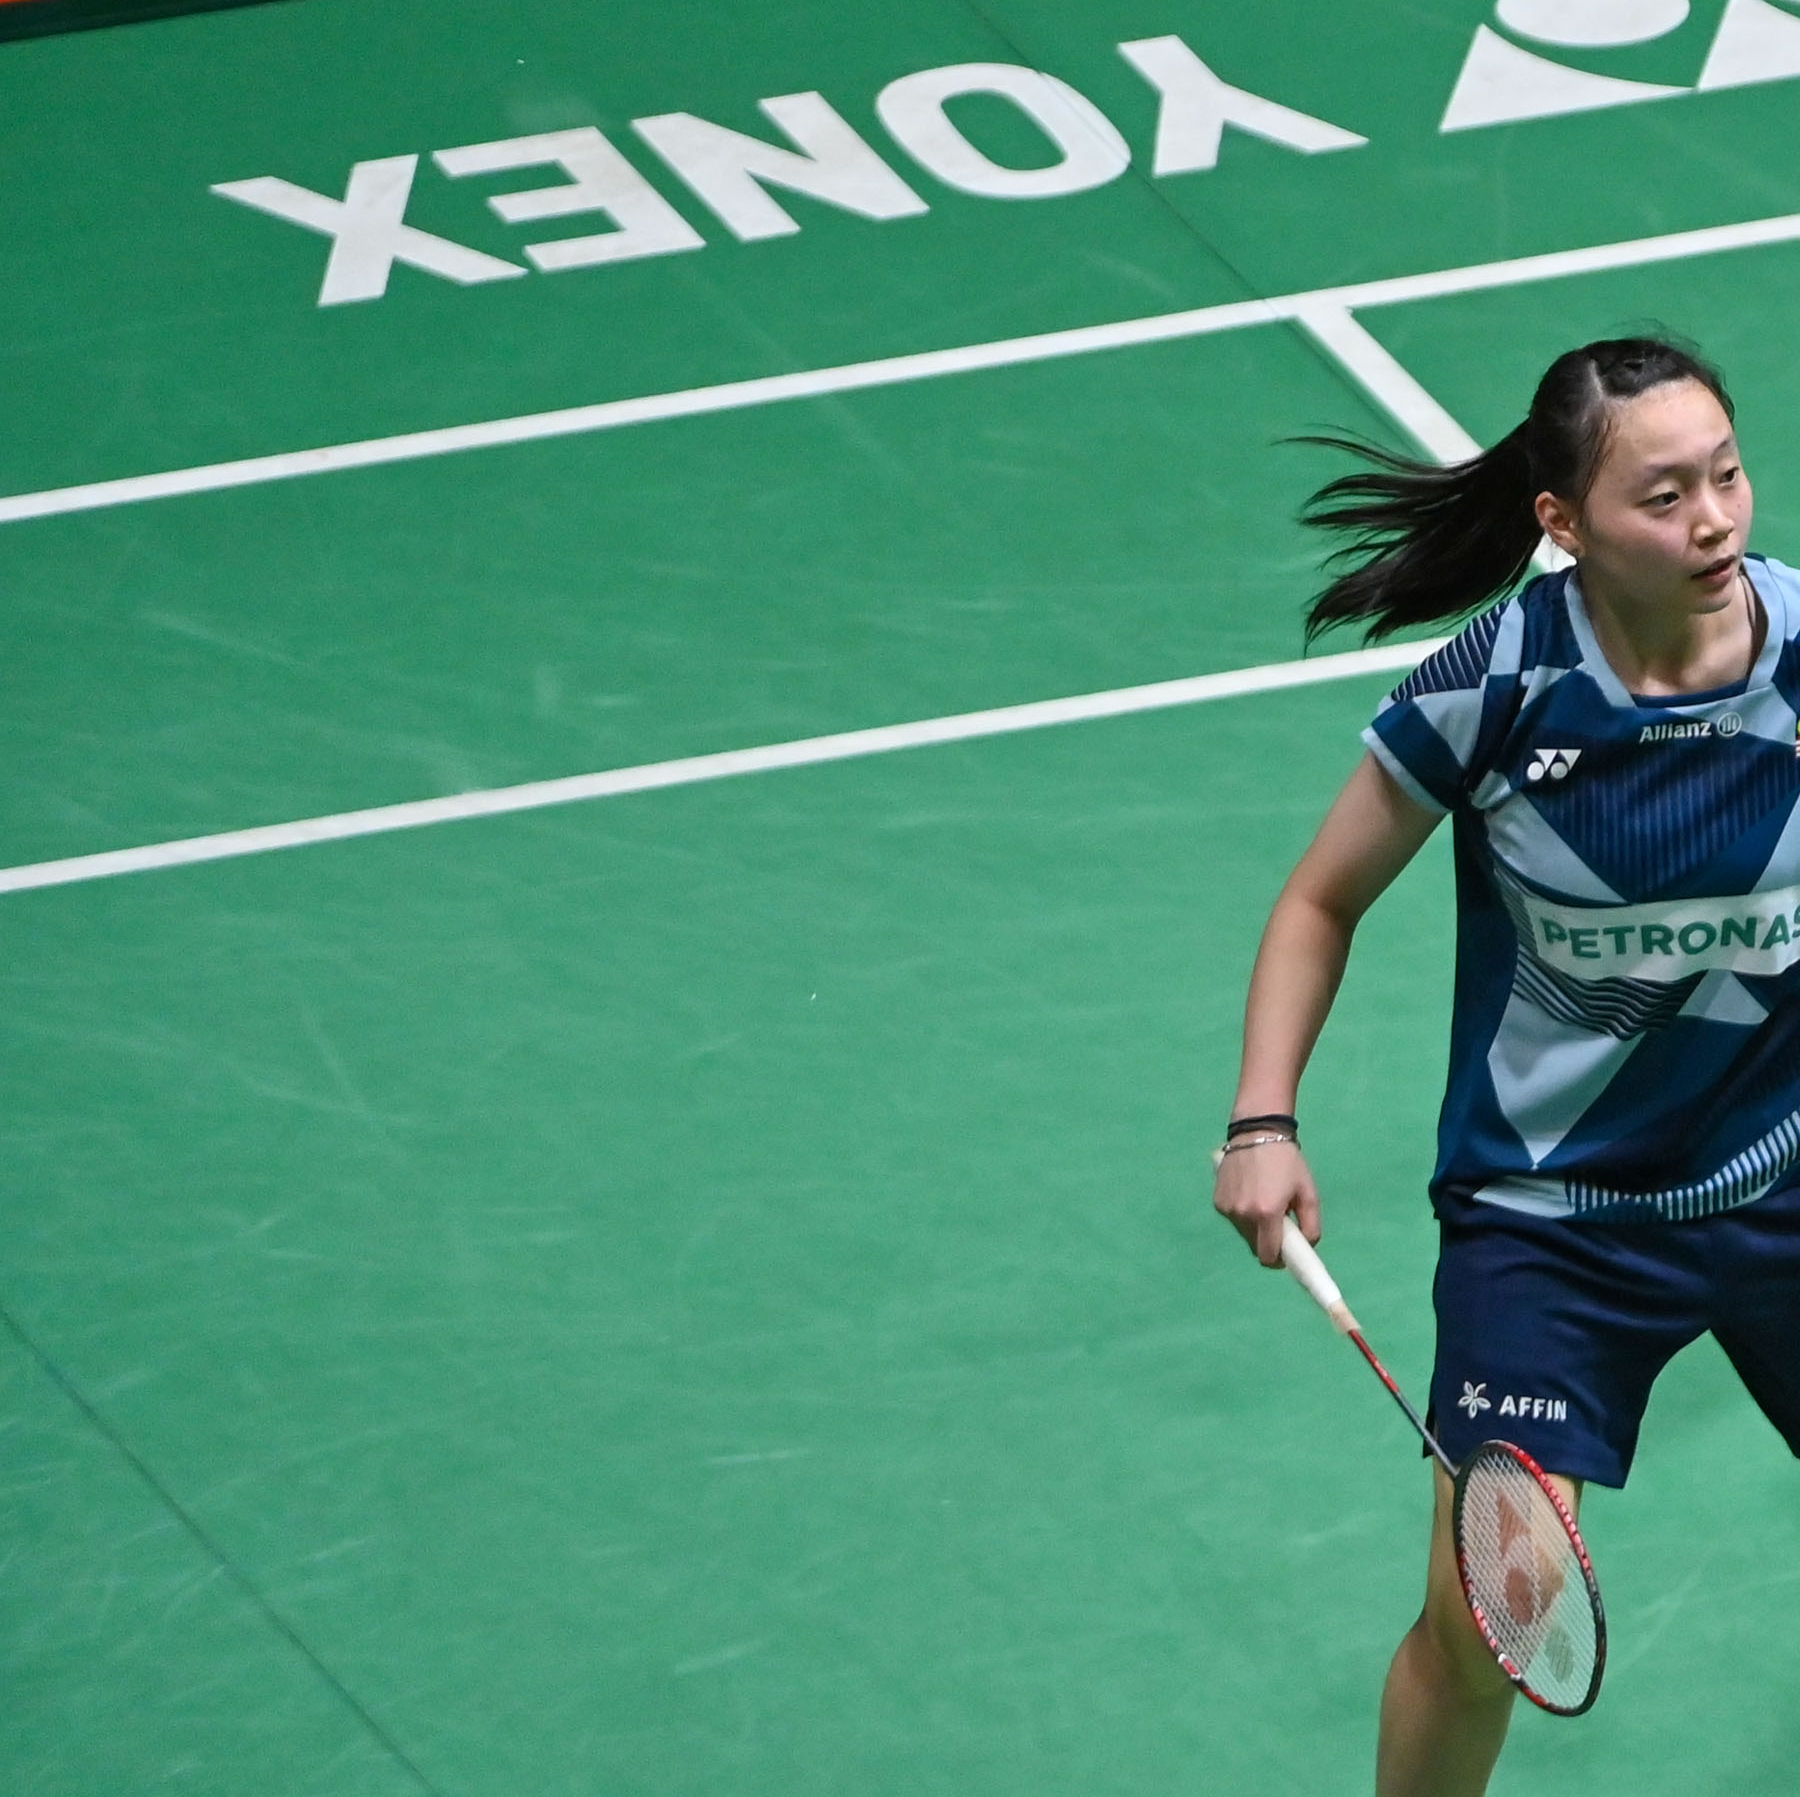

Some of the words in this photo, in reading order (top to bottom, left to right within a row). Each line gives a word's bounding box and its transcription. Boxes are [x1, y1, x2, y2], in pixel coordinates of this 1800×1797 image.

[210, 34, 1369, 307] YONEX
[1639, 721, 1712, 743] Allianz
[1499, 1395, 1567, 1421] AFFIN
